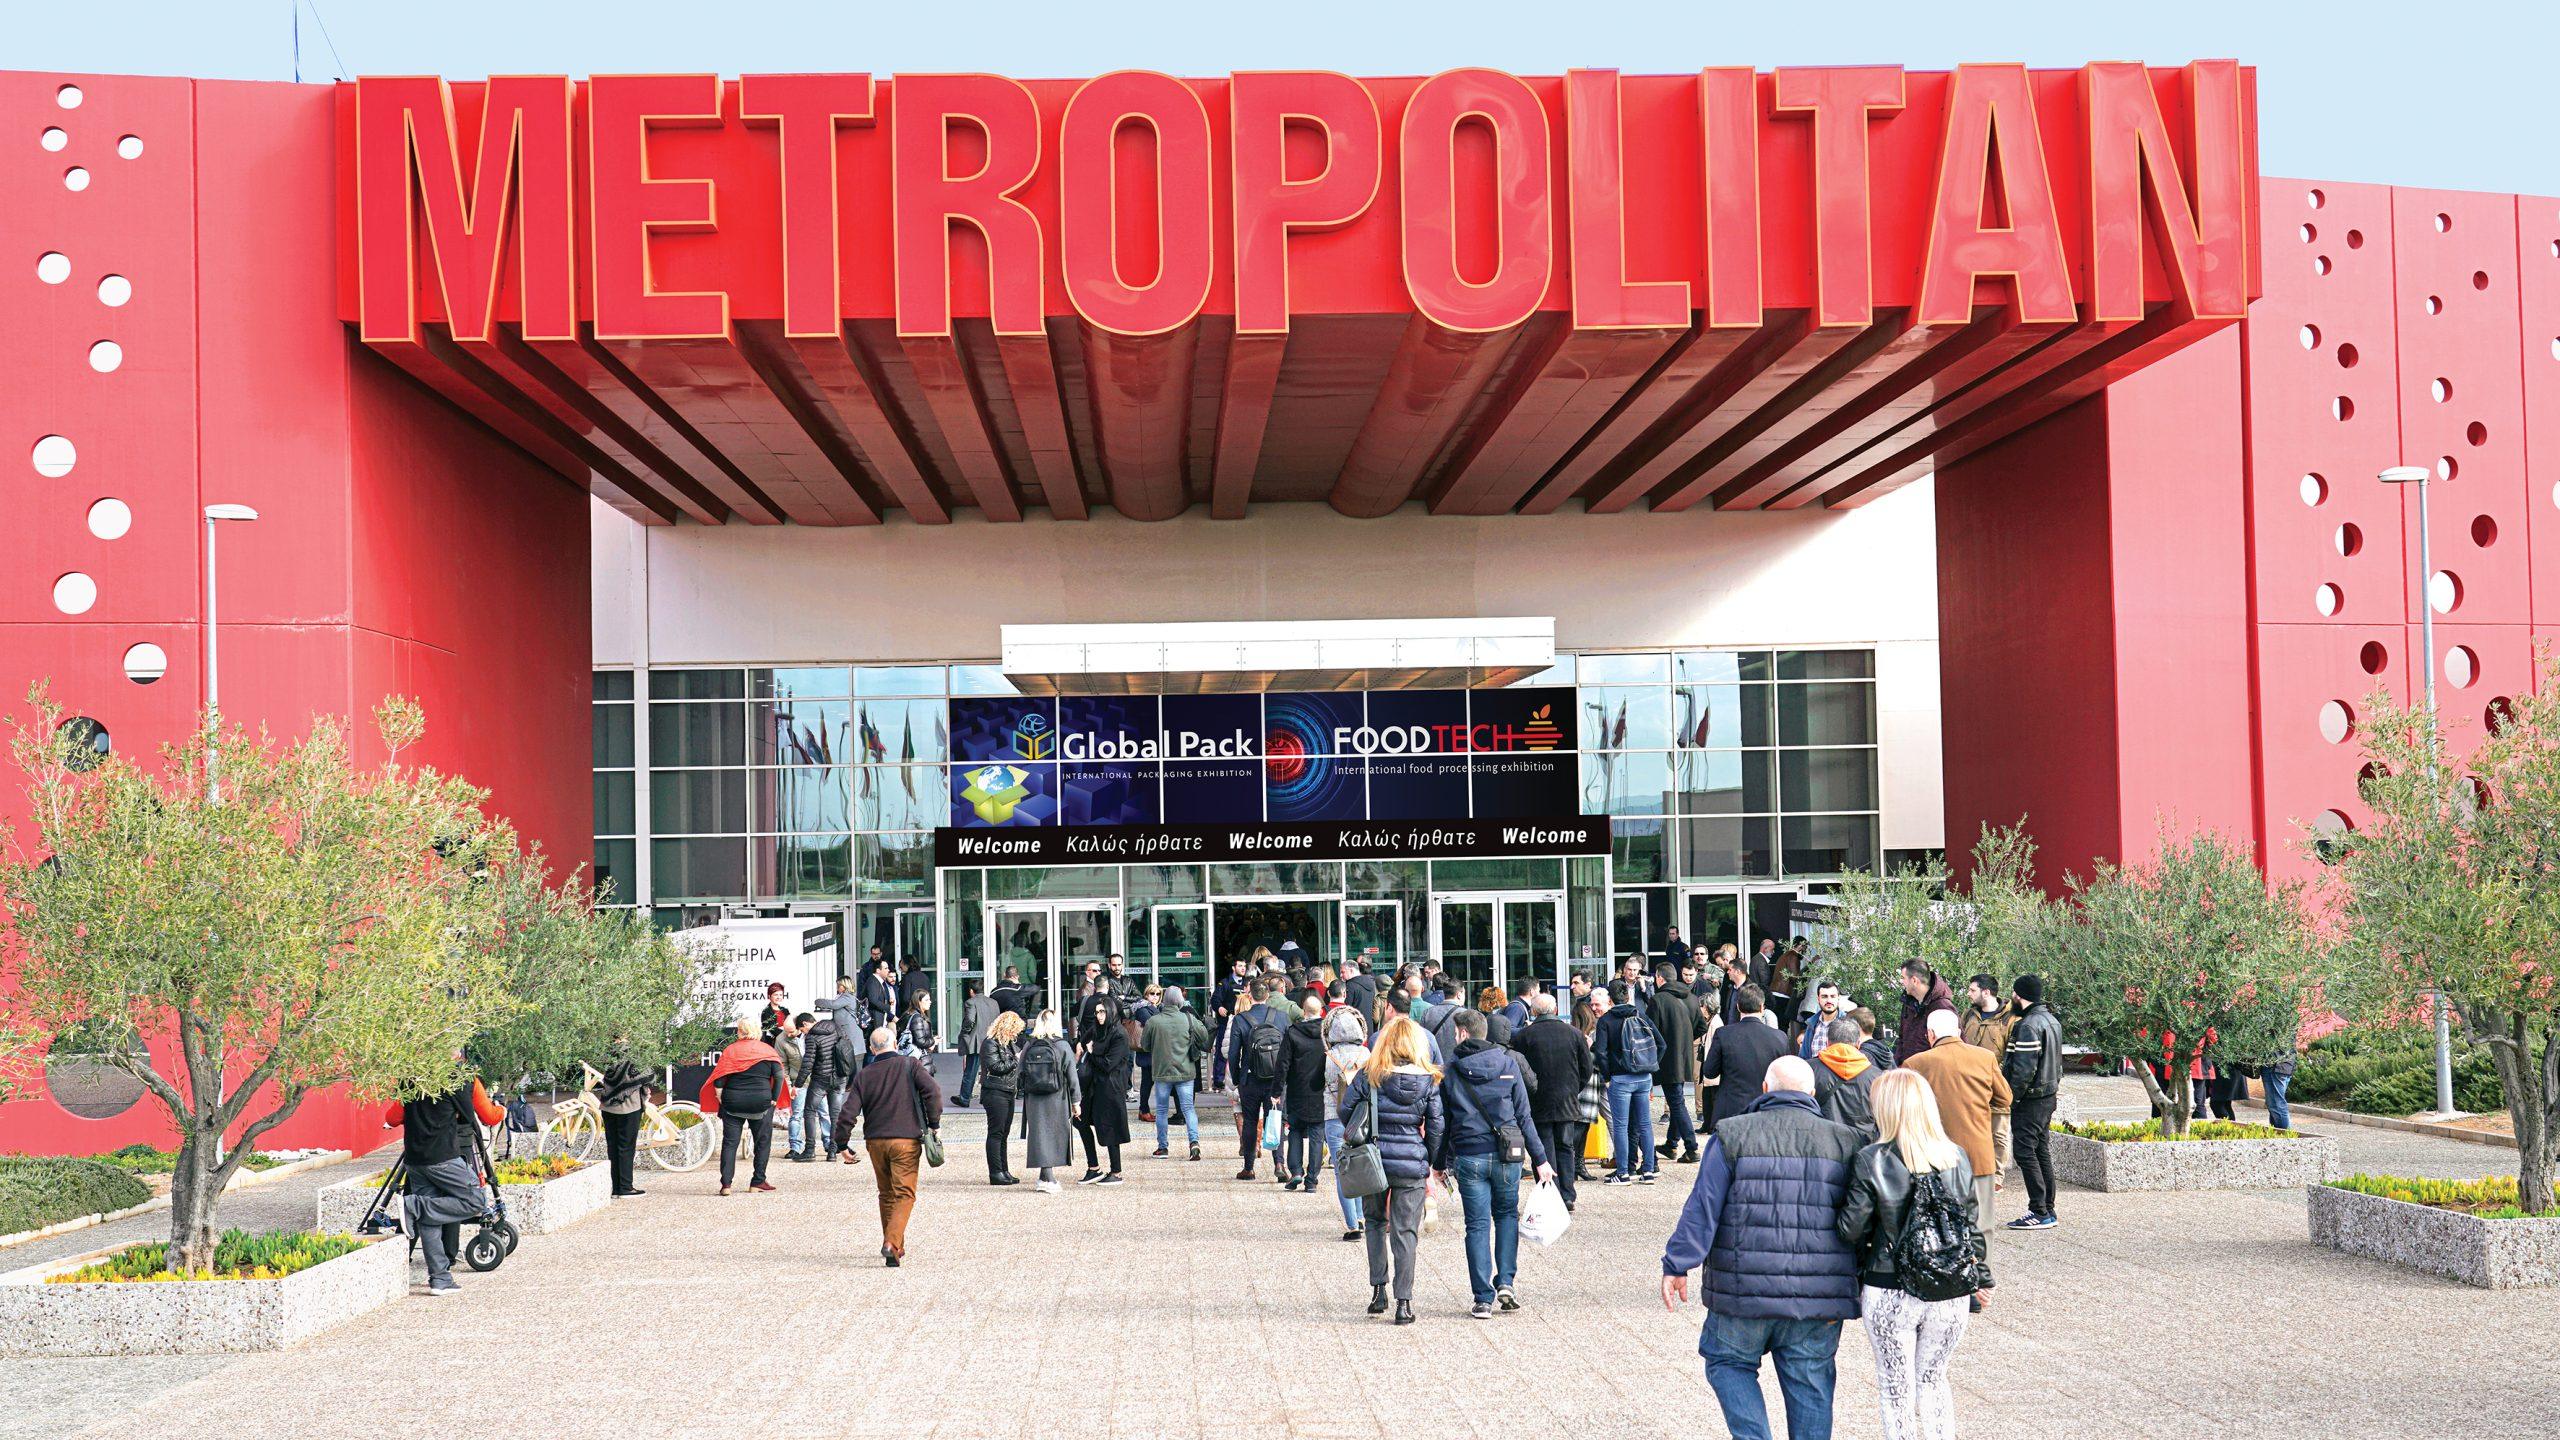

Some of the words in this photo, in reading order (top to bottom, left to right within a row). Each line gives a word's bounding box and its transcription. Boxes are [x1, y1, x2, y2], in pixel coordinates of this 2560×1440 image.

[357, 59, 2252, 345] METROPOLITAN
[1062, 729, 1170, 759] Global
[1179, 728, 1254, 757] Pack
[1334, 724, 1513, 755] FOODTECH
[1062, 772, 1133, 780] INTERNATIONAL
[1137, 770, 1193, 779] PACKAGING
[1197, 769, 1252, 778] EXHIBITION
[1334, 763, 1406, 775] International
[1409, 763, 1433, 774] food
[1438, 762, 1499, 776] processing
[1501, 761, 1554, 772] exhibition
[958, 837, 1041, 854] Welcome
[1066, 835, 1127, 855] Καλώς
[1135, 833, 1203, 855] ήρθατε
[1229, 832, 1313, 849] Welcome
[1338, 829, 1400, 849] Καλώς
[1407, 828, 1476, 850] ήρθατε
[1502, 826, 1587, 844] Welcome
[703, 979, 770, 989] ΕΠΙΣΚΕΠΤΕΣ
[721, 992, 789, 1001] ΠΡΟΣΚΛΗ
